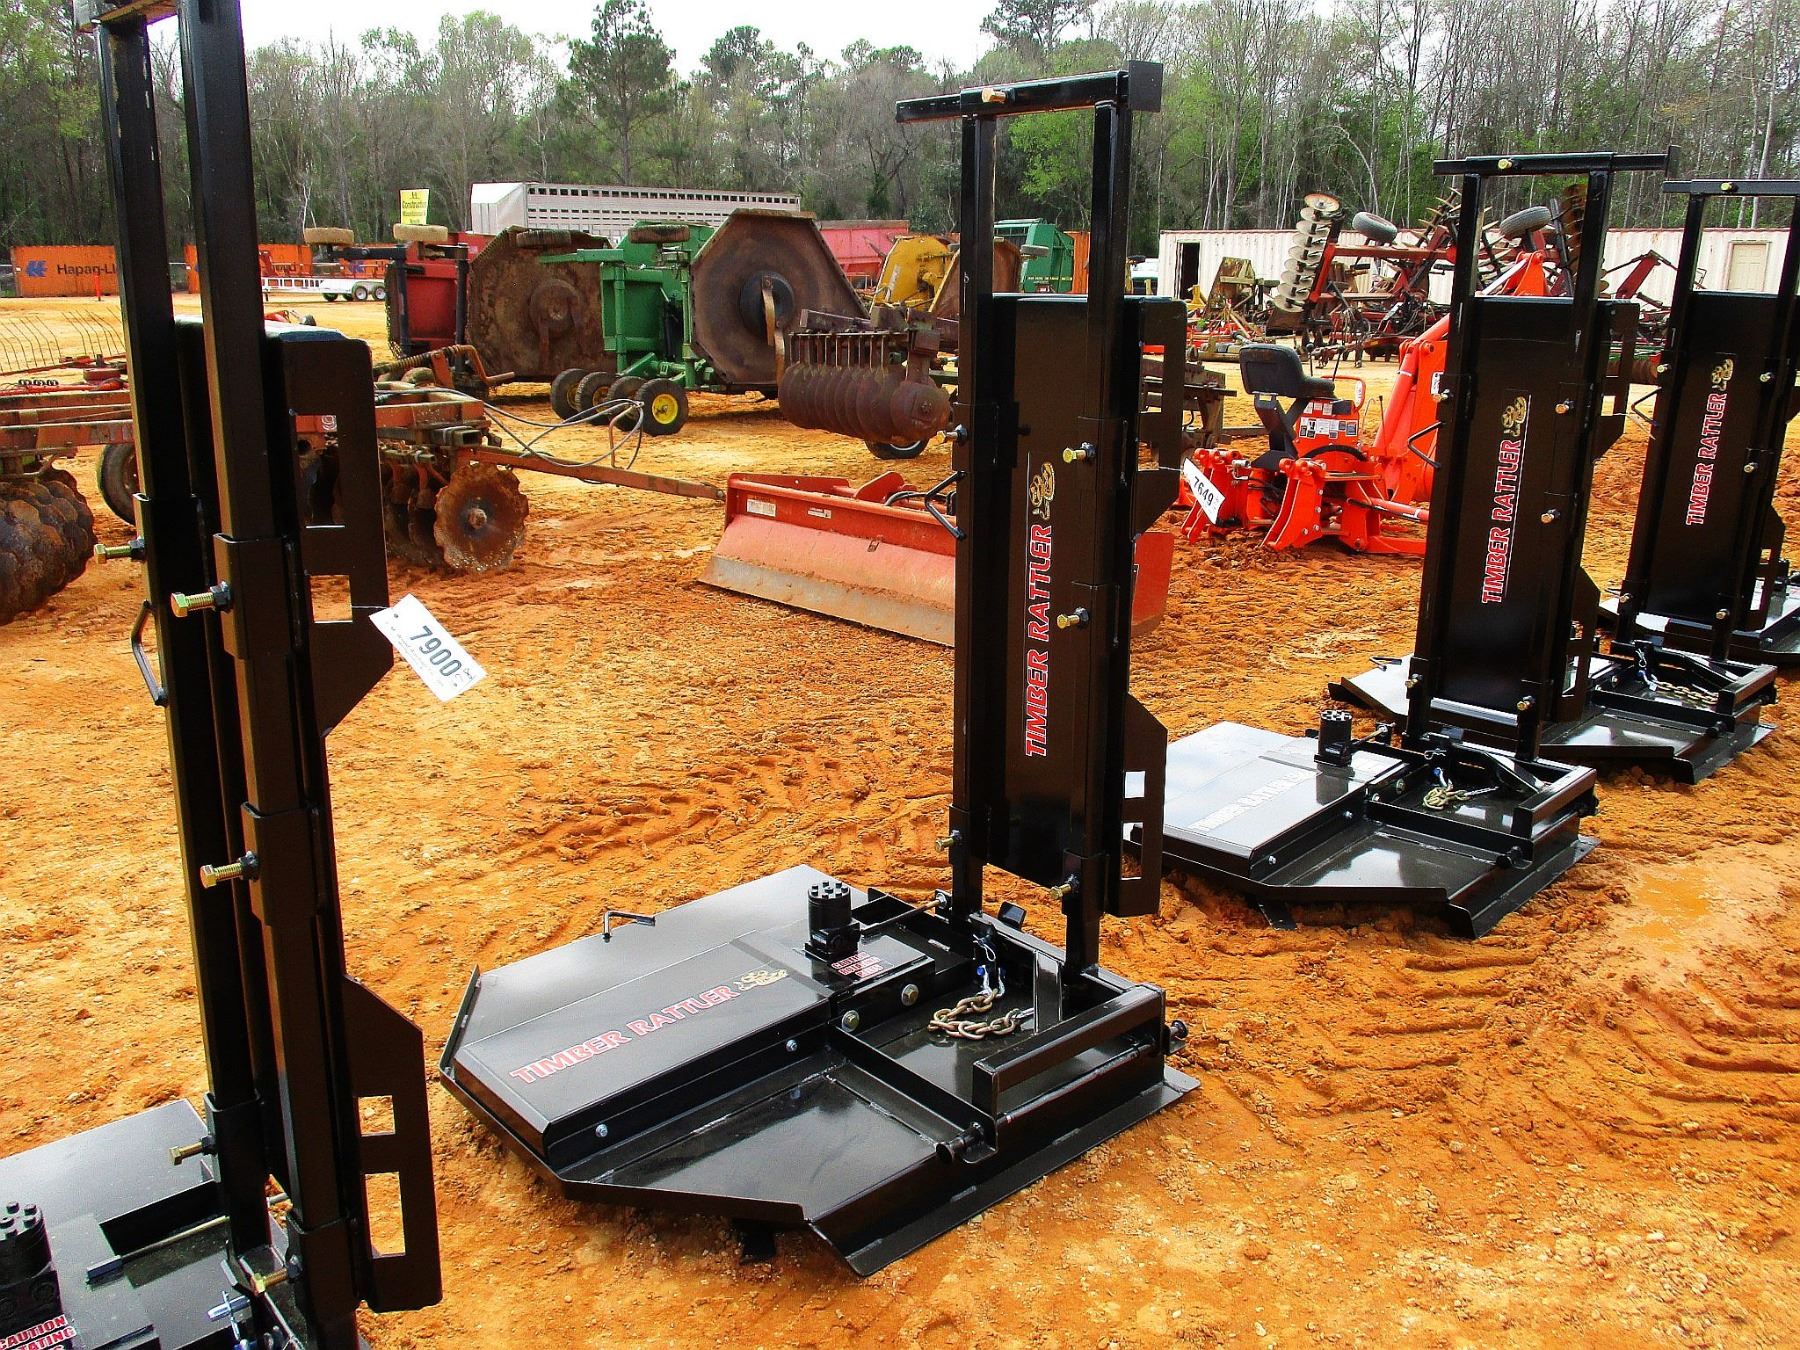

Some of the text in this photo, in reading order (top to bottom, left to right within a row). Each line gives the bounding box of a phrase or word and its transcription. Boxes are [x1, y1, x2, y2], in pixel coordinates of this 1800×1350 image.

[1193, 475, 1214, 506] 7649
[1686, 393, 1728, 526] TIMBER RATTLER
[1482, 438, 1522, 604] TIMBER RATTLER
[409, 625, 462, 677] 7900
[1025, 523, 1052, 757] TIMBER RATTLER
[509, 985, 741, 1084] TIMBER RATTLER
